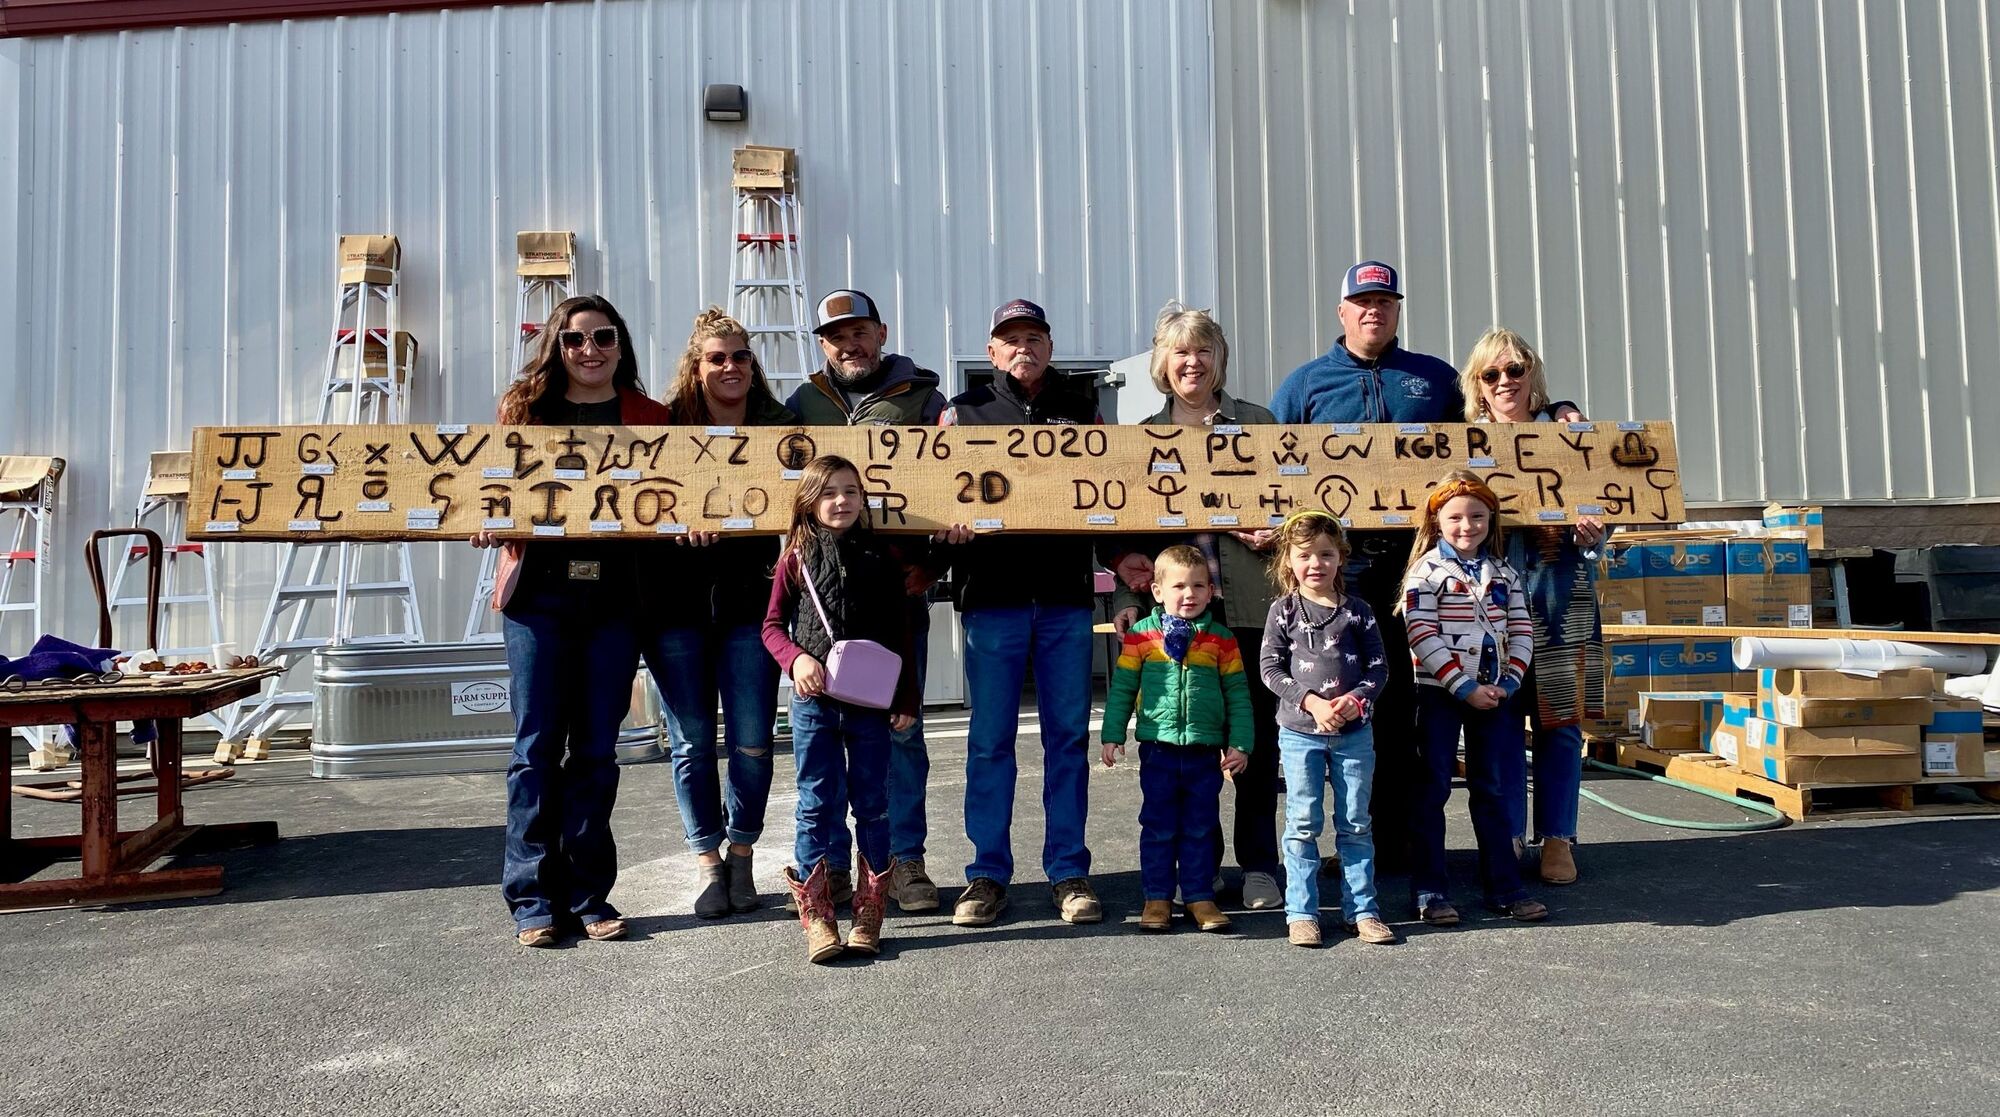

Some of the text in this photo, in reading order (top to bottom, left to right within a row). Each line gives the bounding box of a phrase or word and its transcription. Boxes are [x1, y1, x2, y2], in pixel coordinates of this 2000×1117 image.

[868, 428, 951, 460] 1976
[1007, 428, 1108, 458] 2020
[1395, 433, 1451, 459] KGB
[955, 470, 1010, 503] 2D
[1072, 479, 1127, 510] DO
[453, 694, 479, 704] FARM
